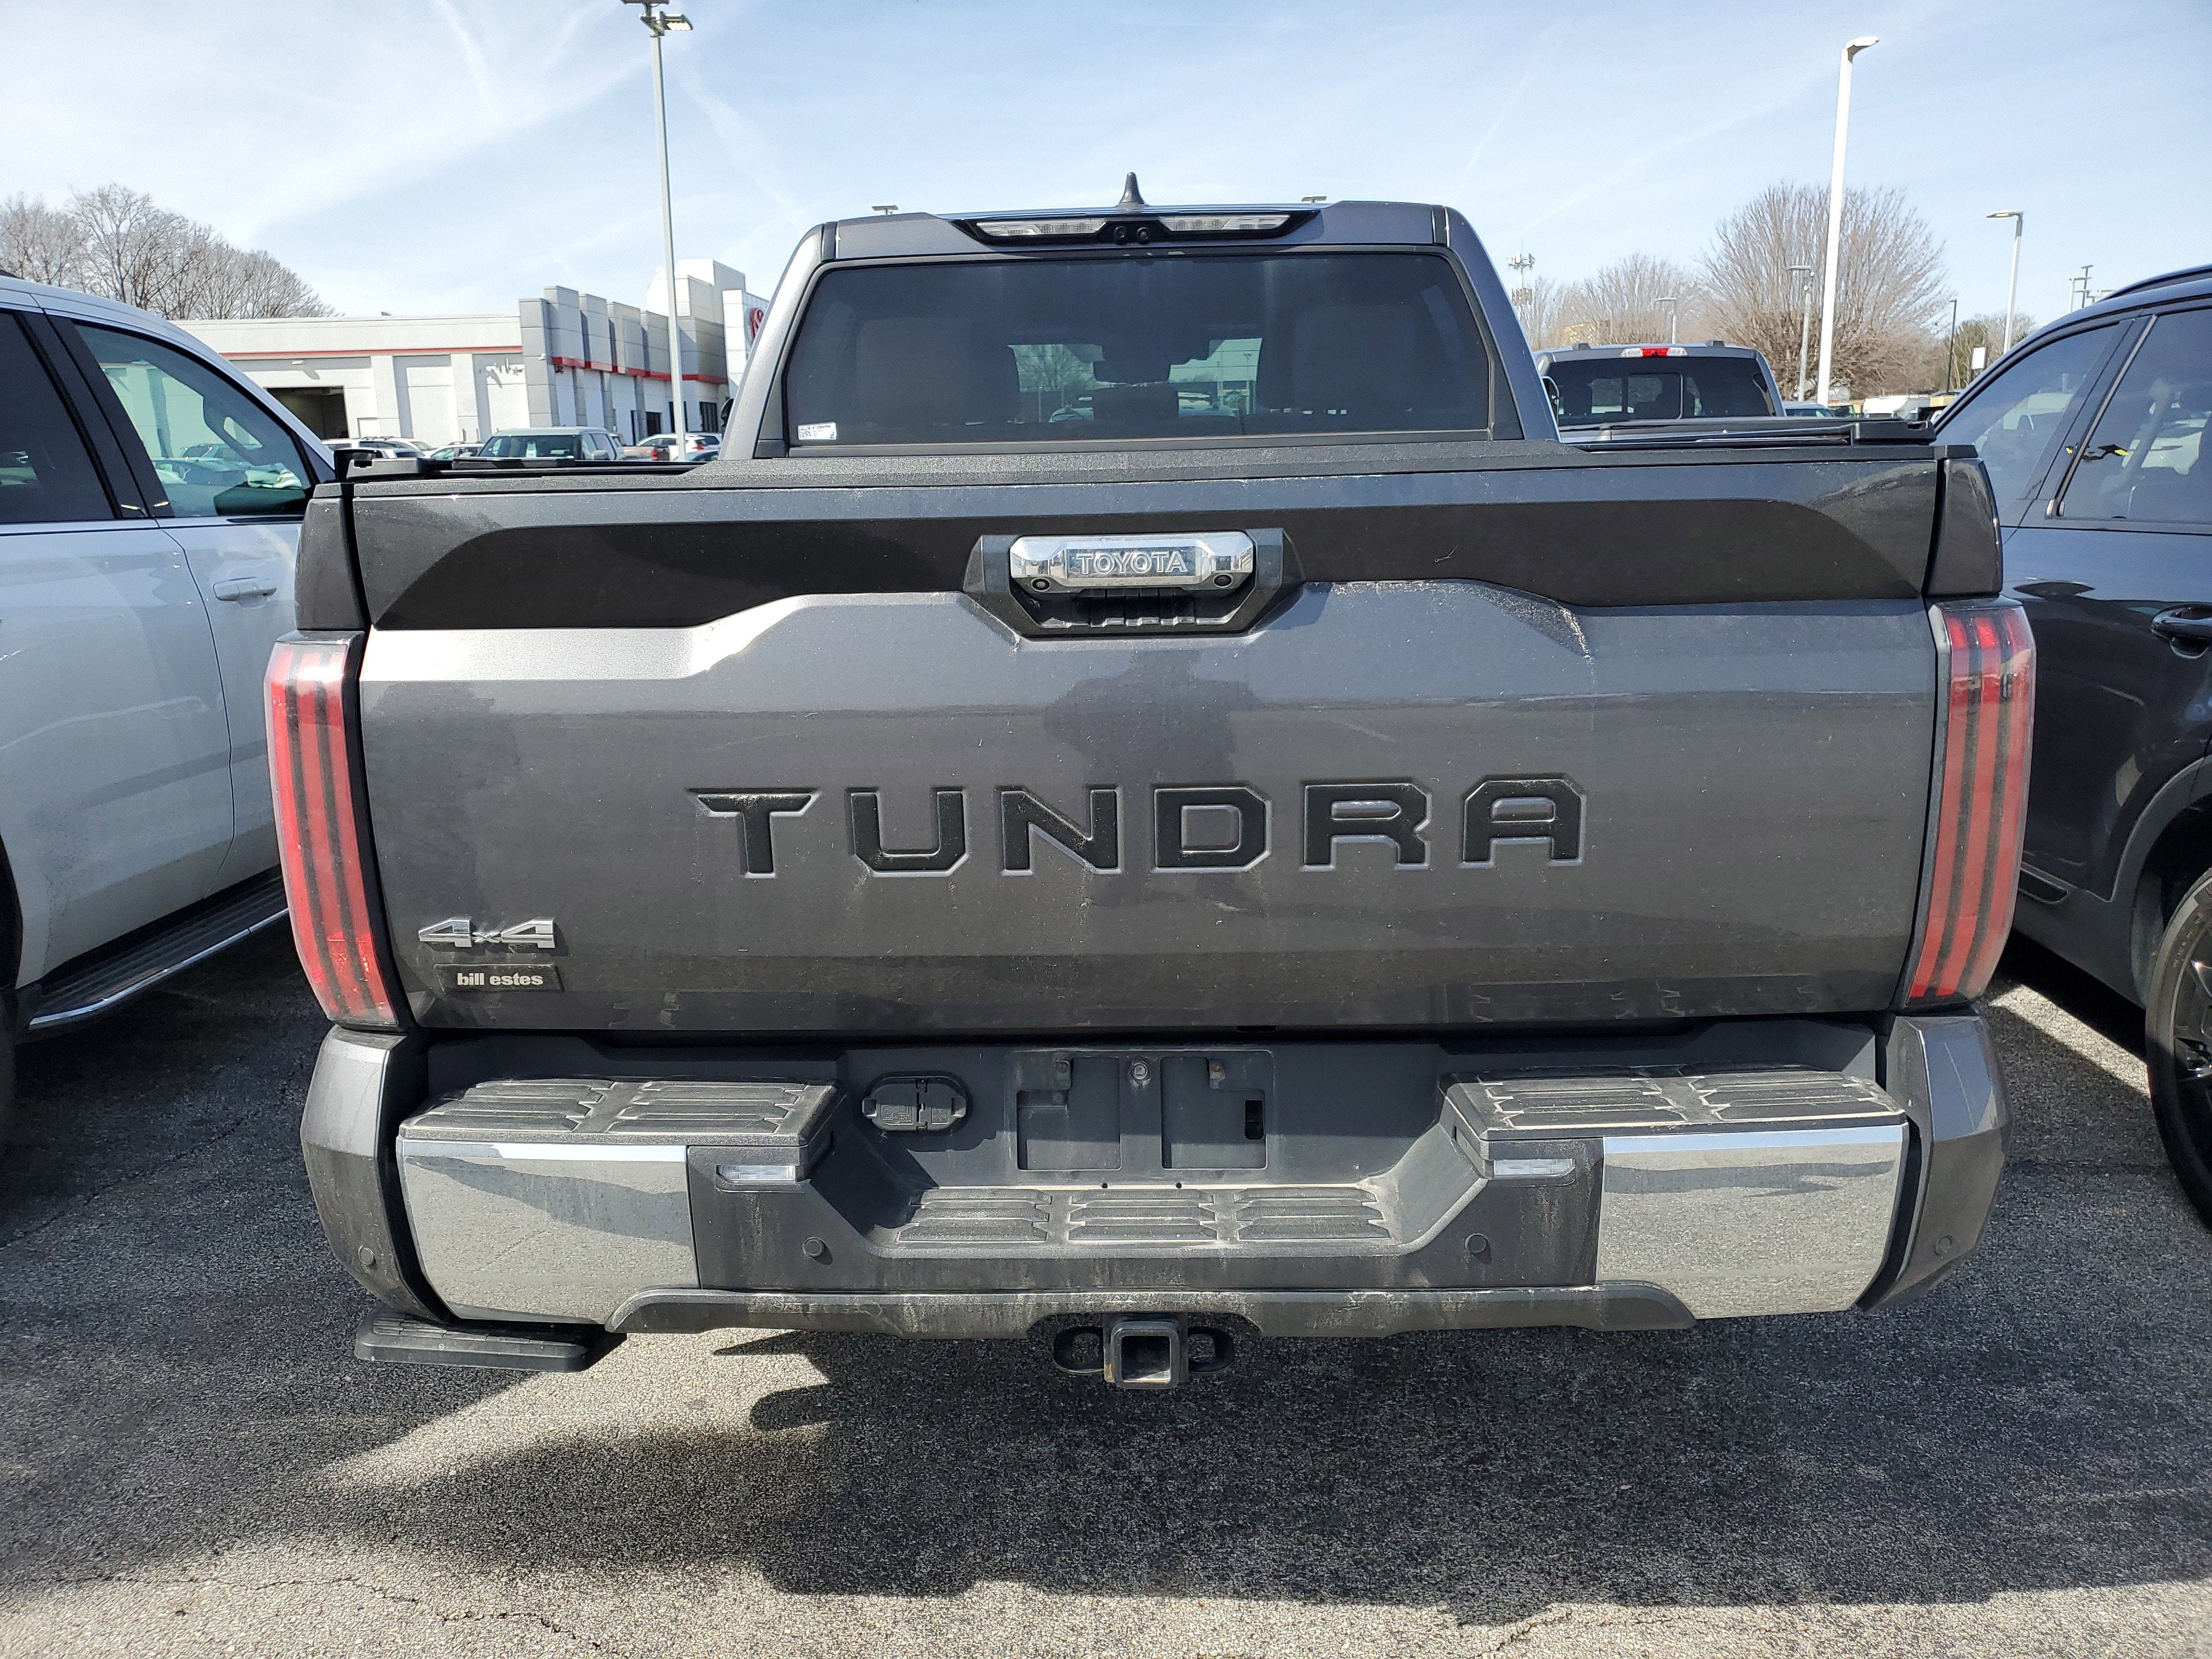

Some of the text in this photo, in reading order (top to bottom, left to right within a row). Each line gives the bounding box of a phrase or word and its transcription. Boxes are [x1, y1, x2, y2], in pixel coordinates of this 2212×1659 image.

[1076, 550, 1187, 574] TOYOTA
[689, 775, 1584, 877] TUNDRA
[418, 917, 556, 949] 4x4
[457, 973, 544, 985] bill estes
